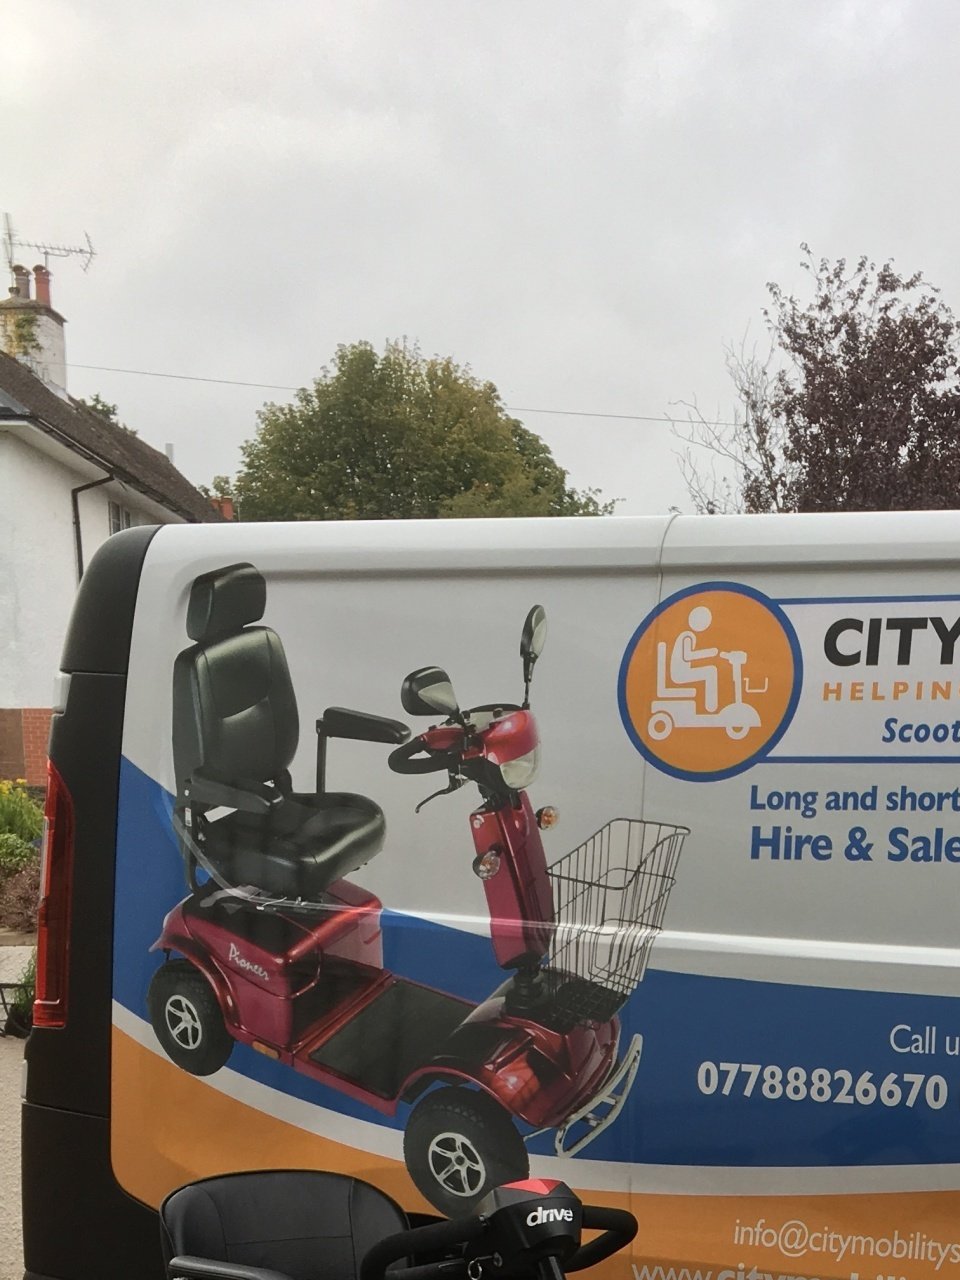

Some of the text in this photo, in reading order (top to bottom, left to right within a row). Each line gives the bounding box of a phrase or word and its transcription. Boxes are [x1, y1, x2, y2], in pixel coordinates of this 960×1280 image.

[749, 784, 818, 819] Long
[824, 785, 879, 812] and
[750, 825, 833, 862] Hire
[843, 826, 875, 863] &
[889, 1024, 937, 1058] Call
[697, 1060, 948, 1110] 07788826670
[526, 1206, 573, 1227] drive
